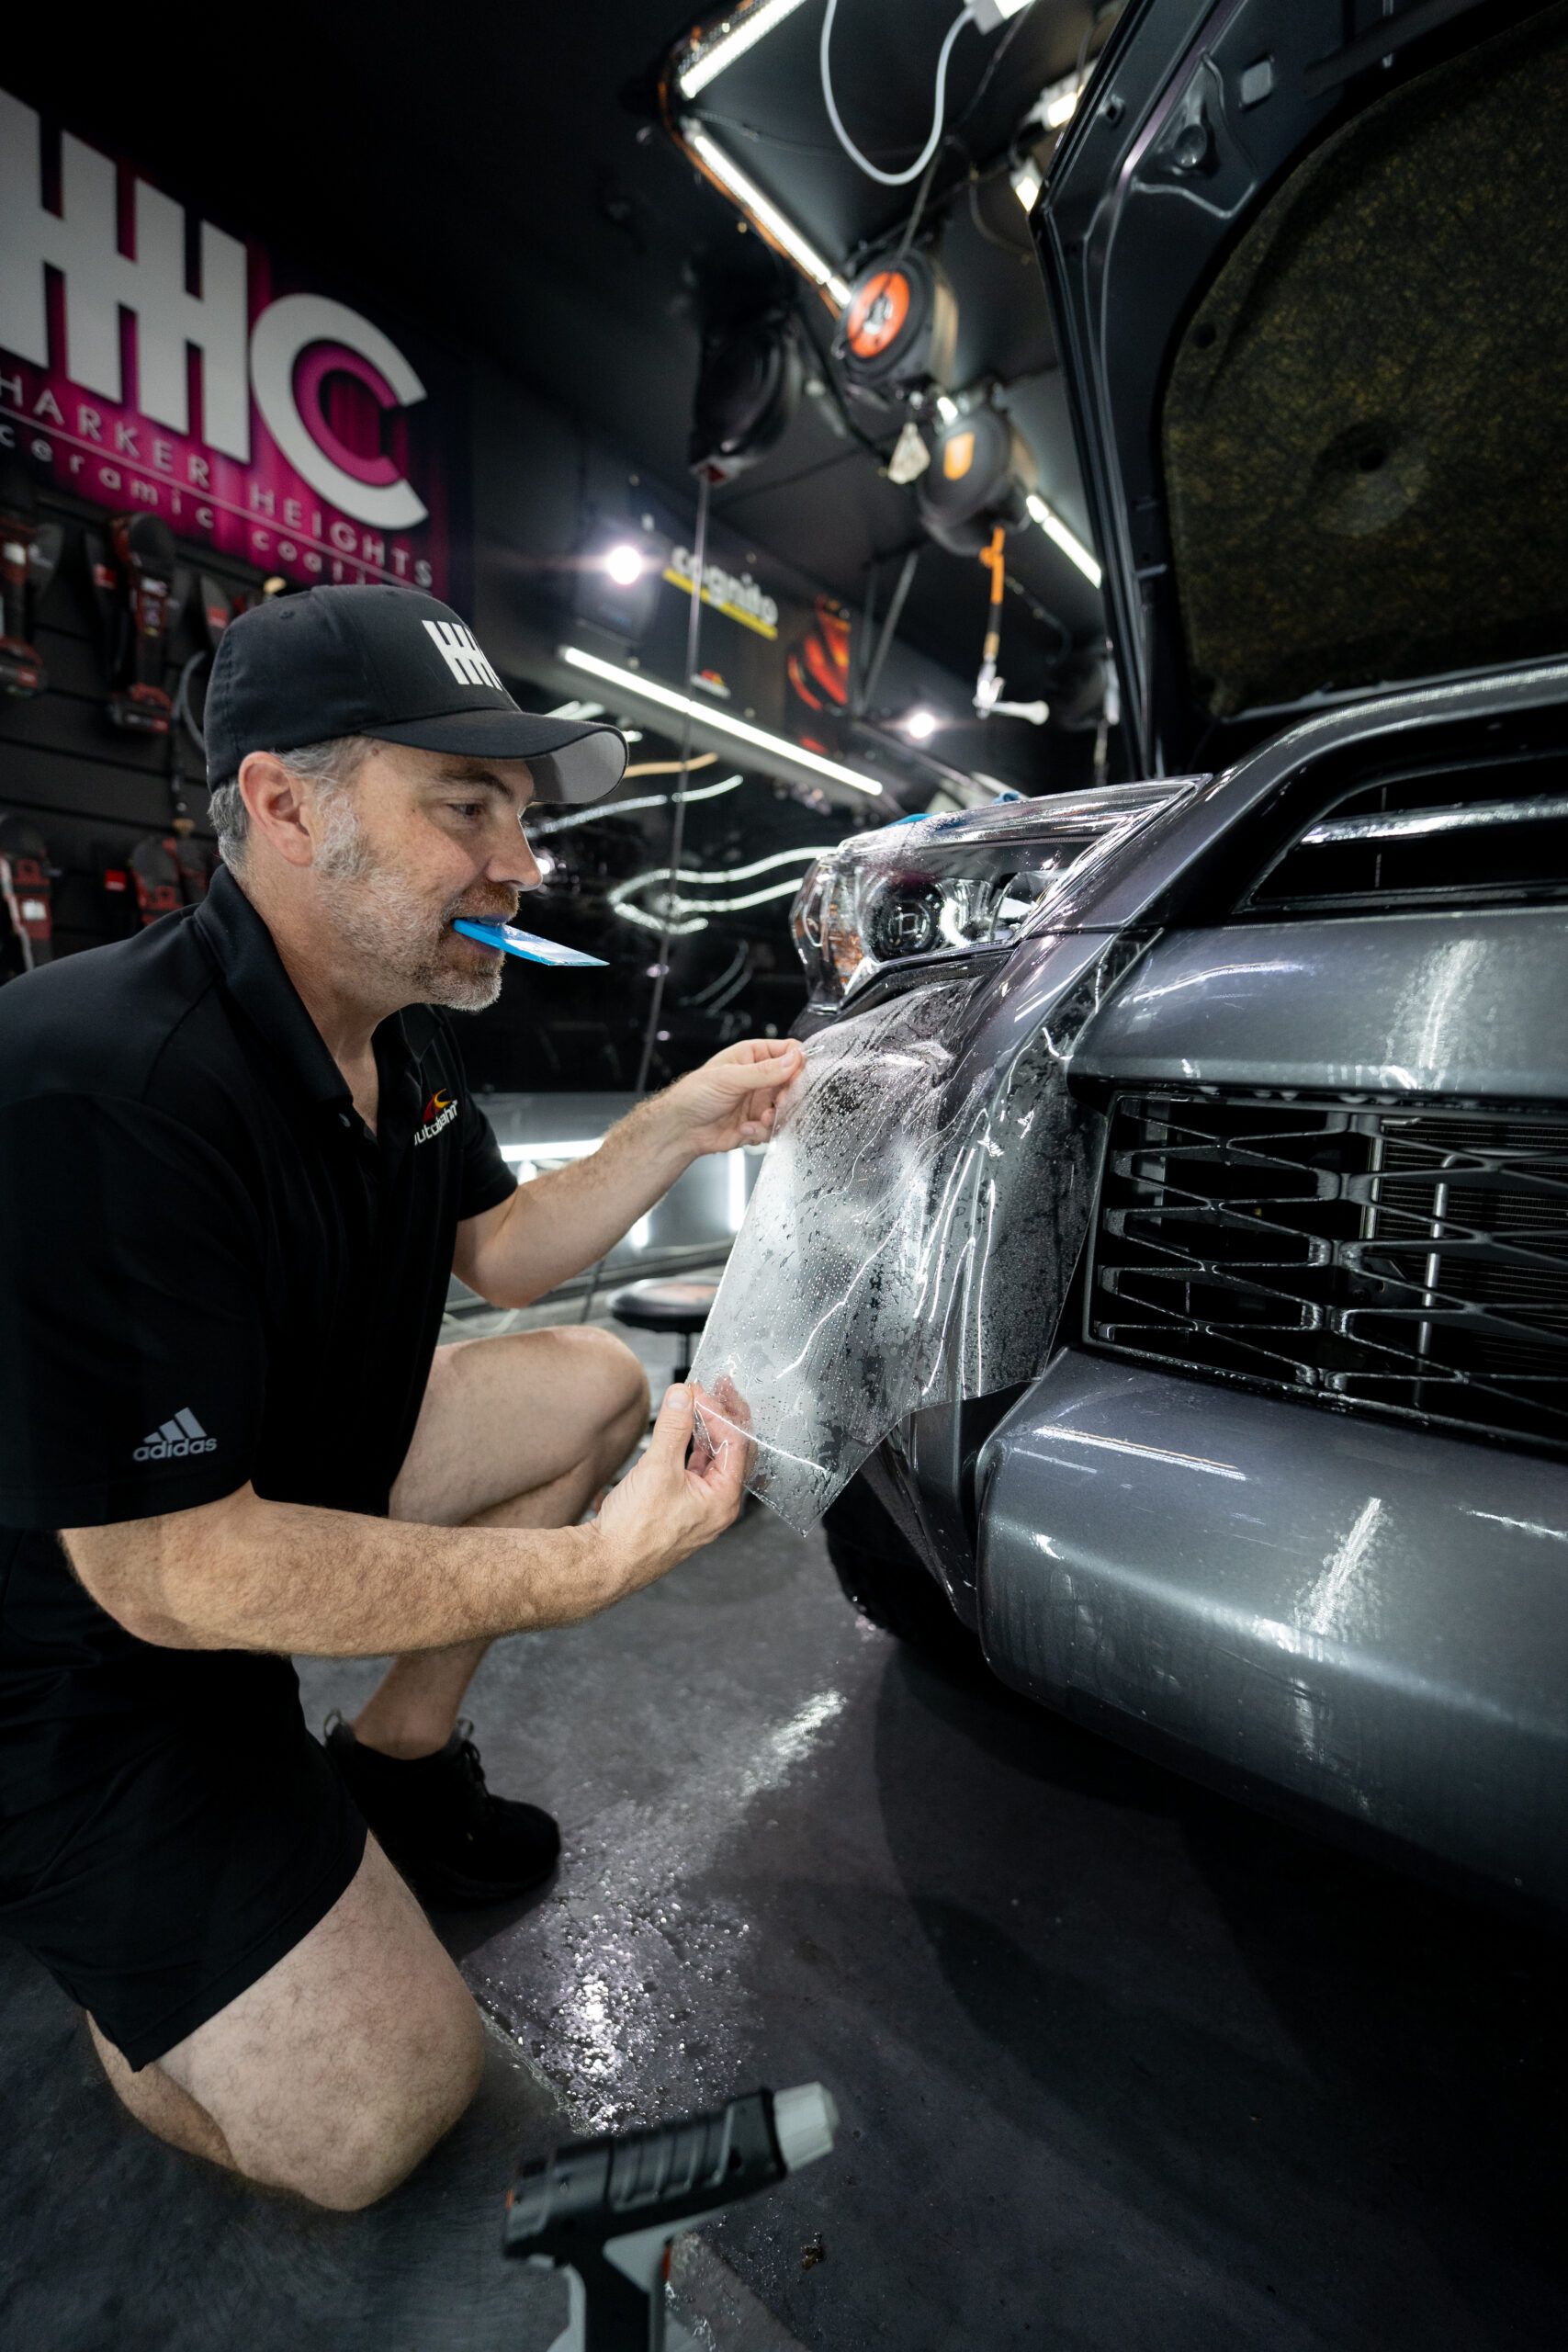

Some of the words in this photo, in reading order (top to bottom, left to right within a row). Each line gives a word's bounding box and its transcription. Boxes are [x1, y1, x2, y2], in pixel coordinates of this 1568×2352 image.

[0, 373, 210, 491] HARKER
[249, 483, 434, 589] HEIGHTS
[132, 1437, 218, 1462] adidas
